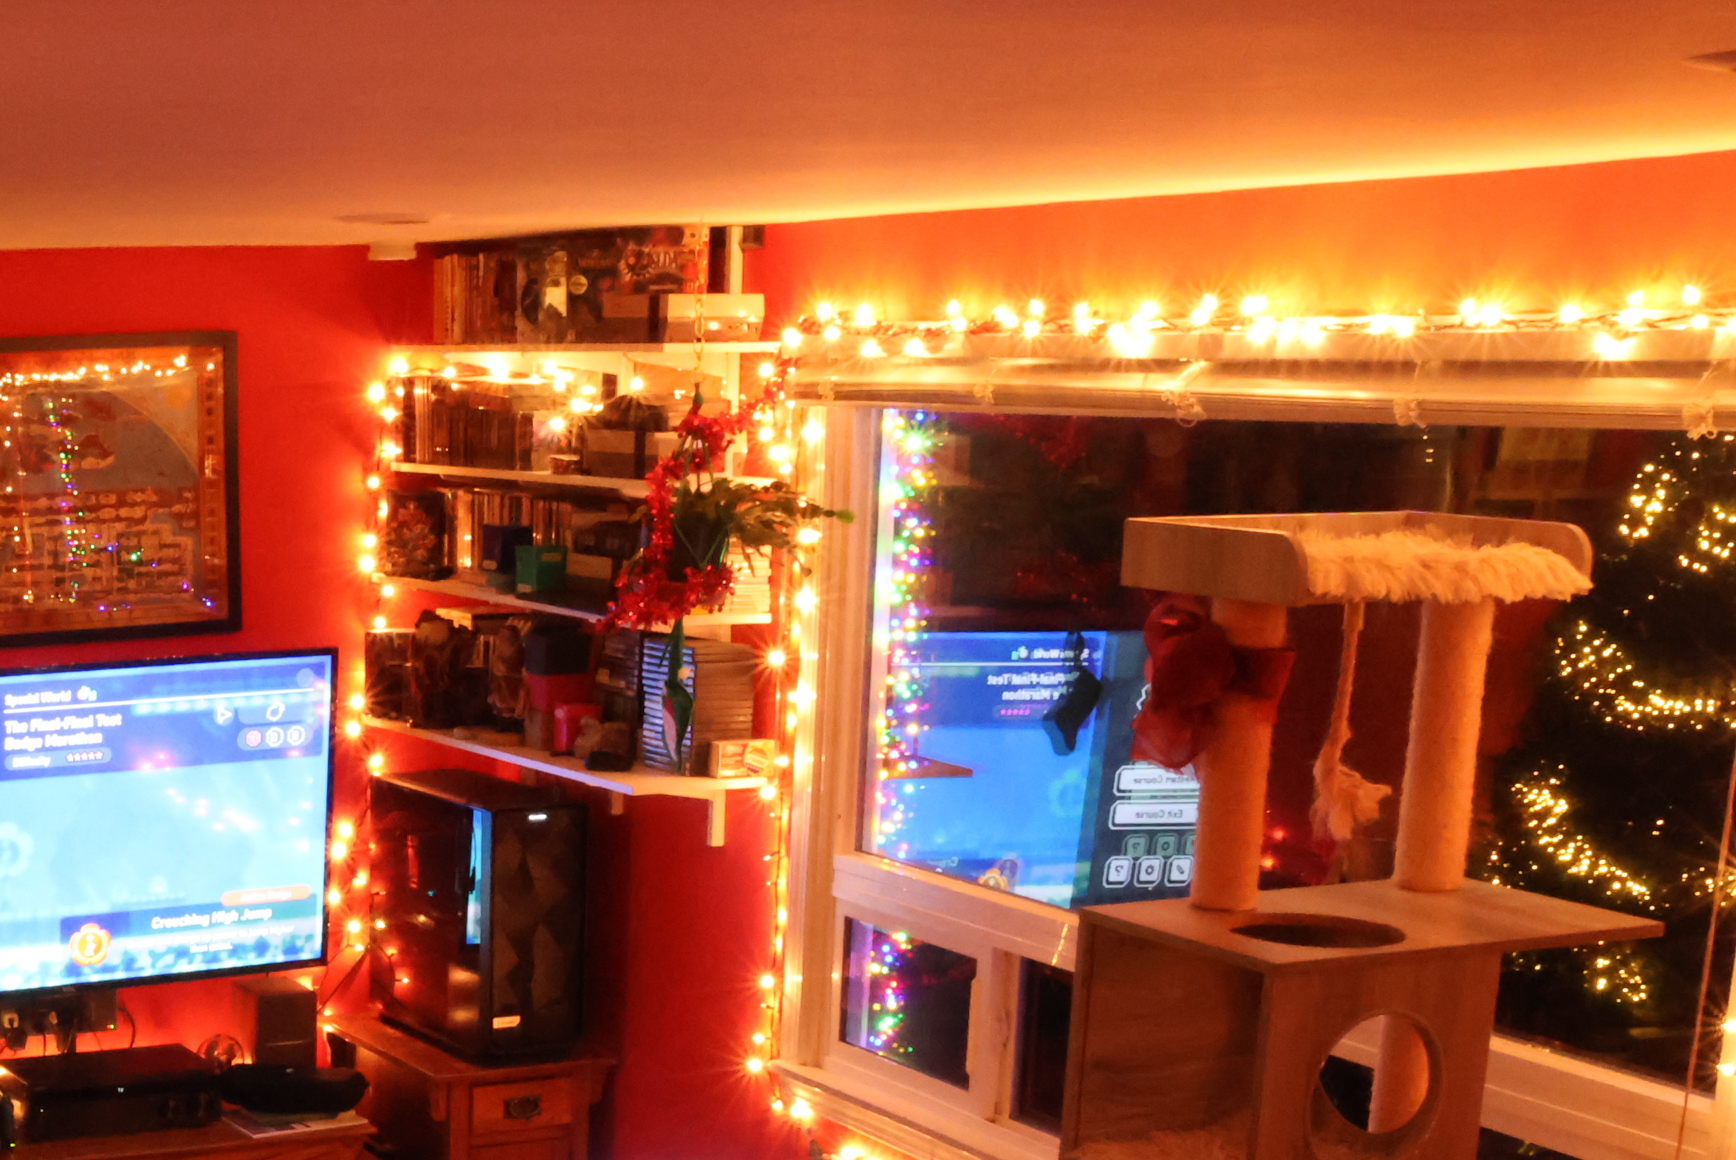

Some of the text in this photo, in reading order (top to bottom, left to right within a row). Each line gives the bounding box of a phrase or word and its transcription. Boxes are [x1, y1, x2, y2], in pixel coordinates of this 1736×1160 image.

[5, 690, 72, 708] Special World
[4, 720, 28, 734] The
[96, 714, 122, 727] Test
[45, 732, 103, 747] Marathon
[151, 907, 272, 930] Crouching High Jump
